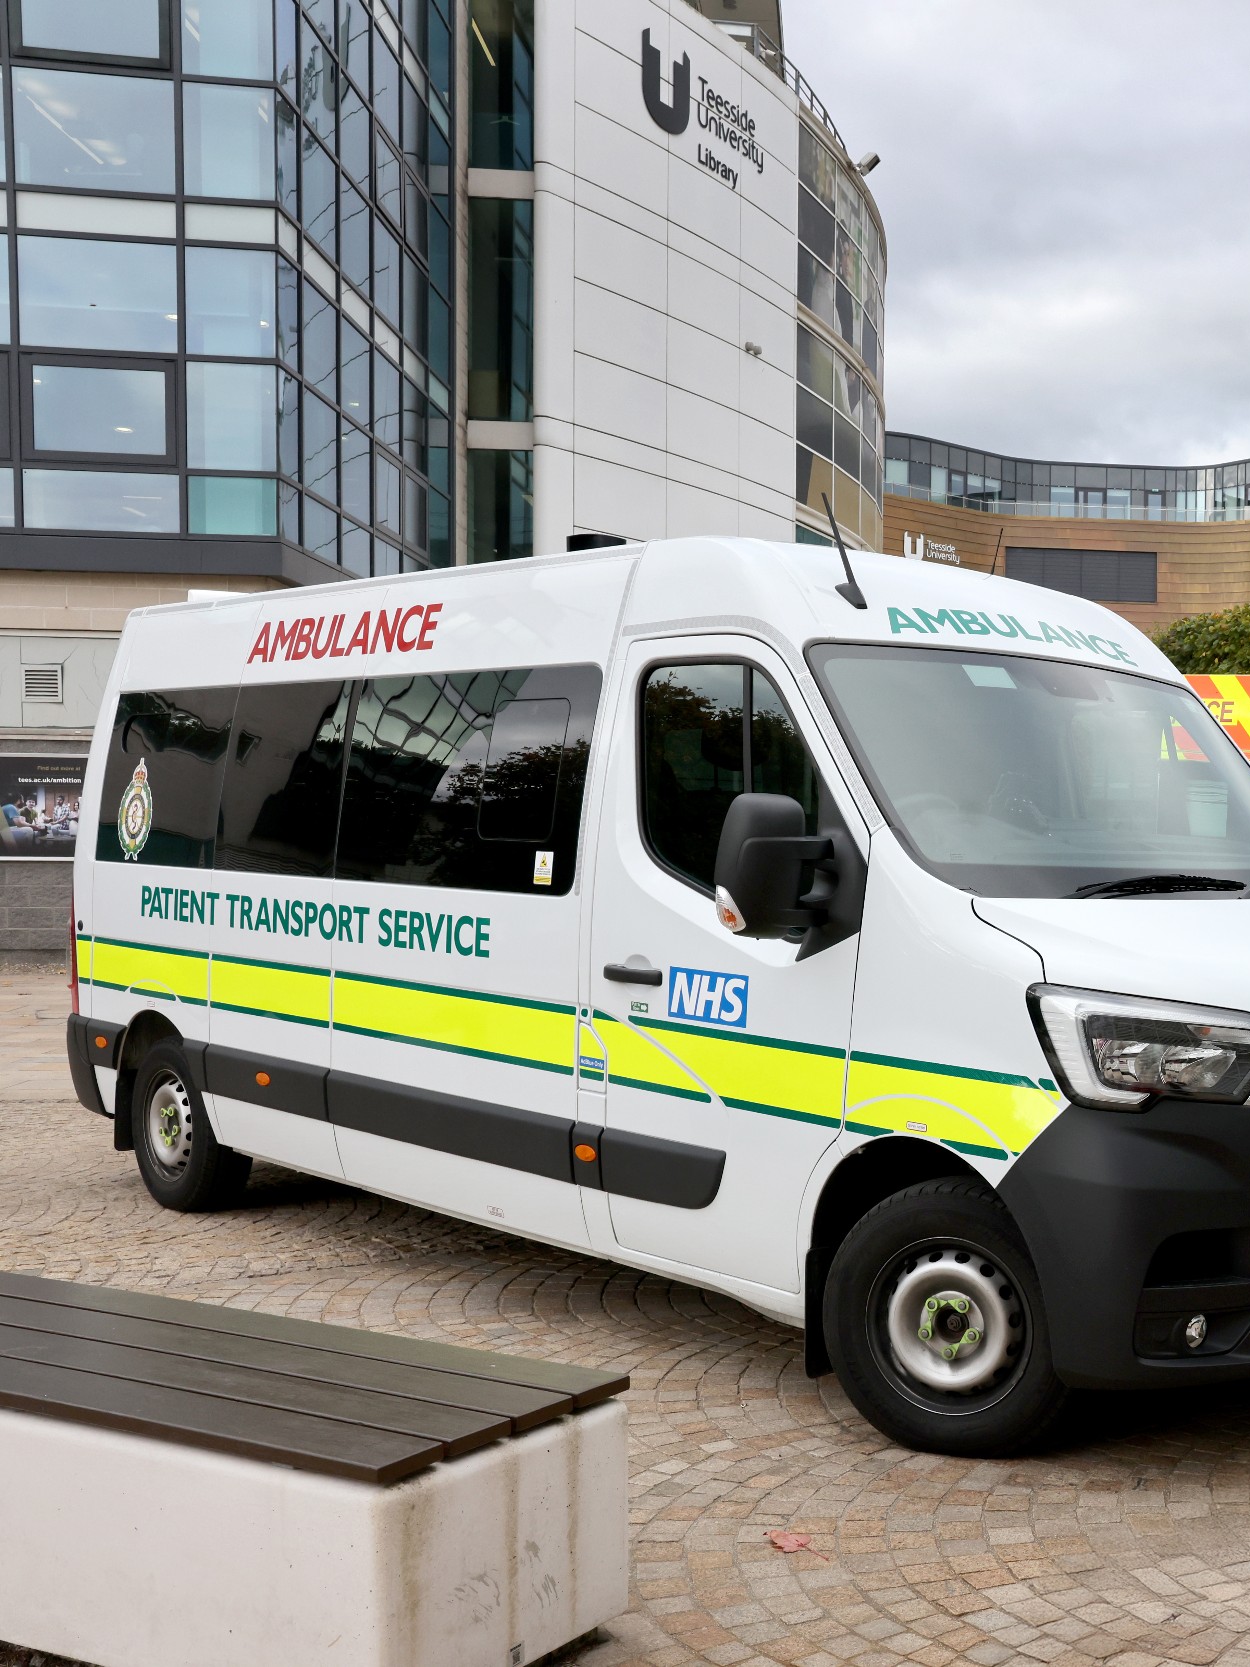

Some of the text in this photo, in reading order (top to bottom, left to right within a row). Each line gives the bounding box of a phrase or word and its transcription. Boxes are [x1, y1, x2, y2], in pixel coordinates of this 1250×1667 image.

[697, 101, 764, 174] University
[698, 75, 756, 138] Teesside
[697, 143, 738, 190] Library
[926, 548, 960, 565] University
[927, 540, 956, 553] Teesside
[246, 602, 444, 665] AMBULANCE
[886, 606, 1139, 668] AMBULANCE
[140, 884, 491, 958] PATIENT TRANSPORT SERVICE
[670, 970, 746, 1023] NHS
